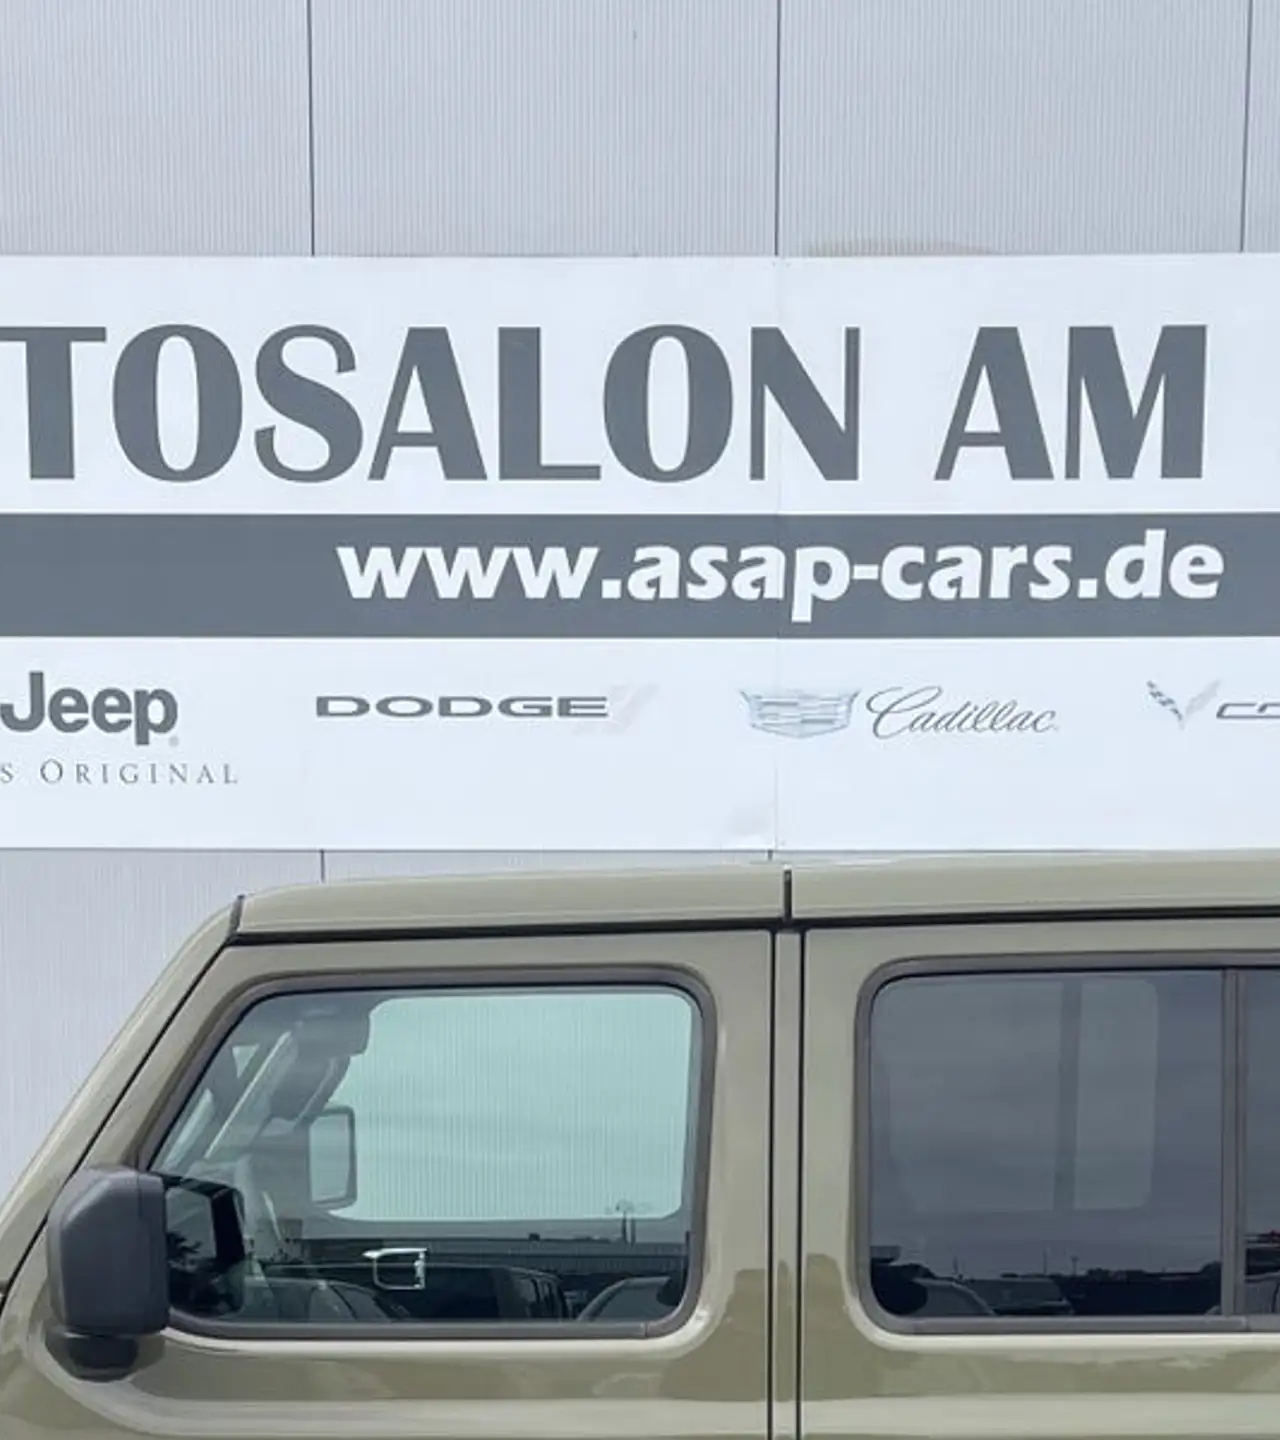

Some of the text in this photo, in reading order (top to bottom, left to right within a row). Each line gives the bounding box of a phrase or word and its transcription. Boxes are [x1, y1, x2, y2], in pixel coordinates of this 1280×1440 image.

[935, 324, 1207, 481] AM
[336, 529, 1224, 622] www.asap-cars.de
[316, 695, 609, 718] DODGE
[866, 685, 1057, 739] Cadillac
